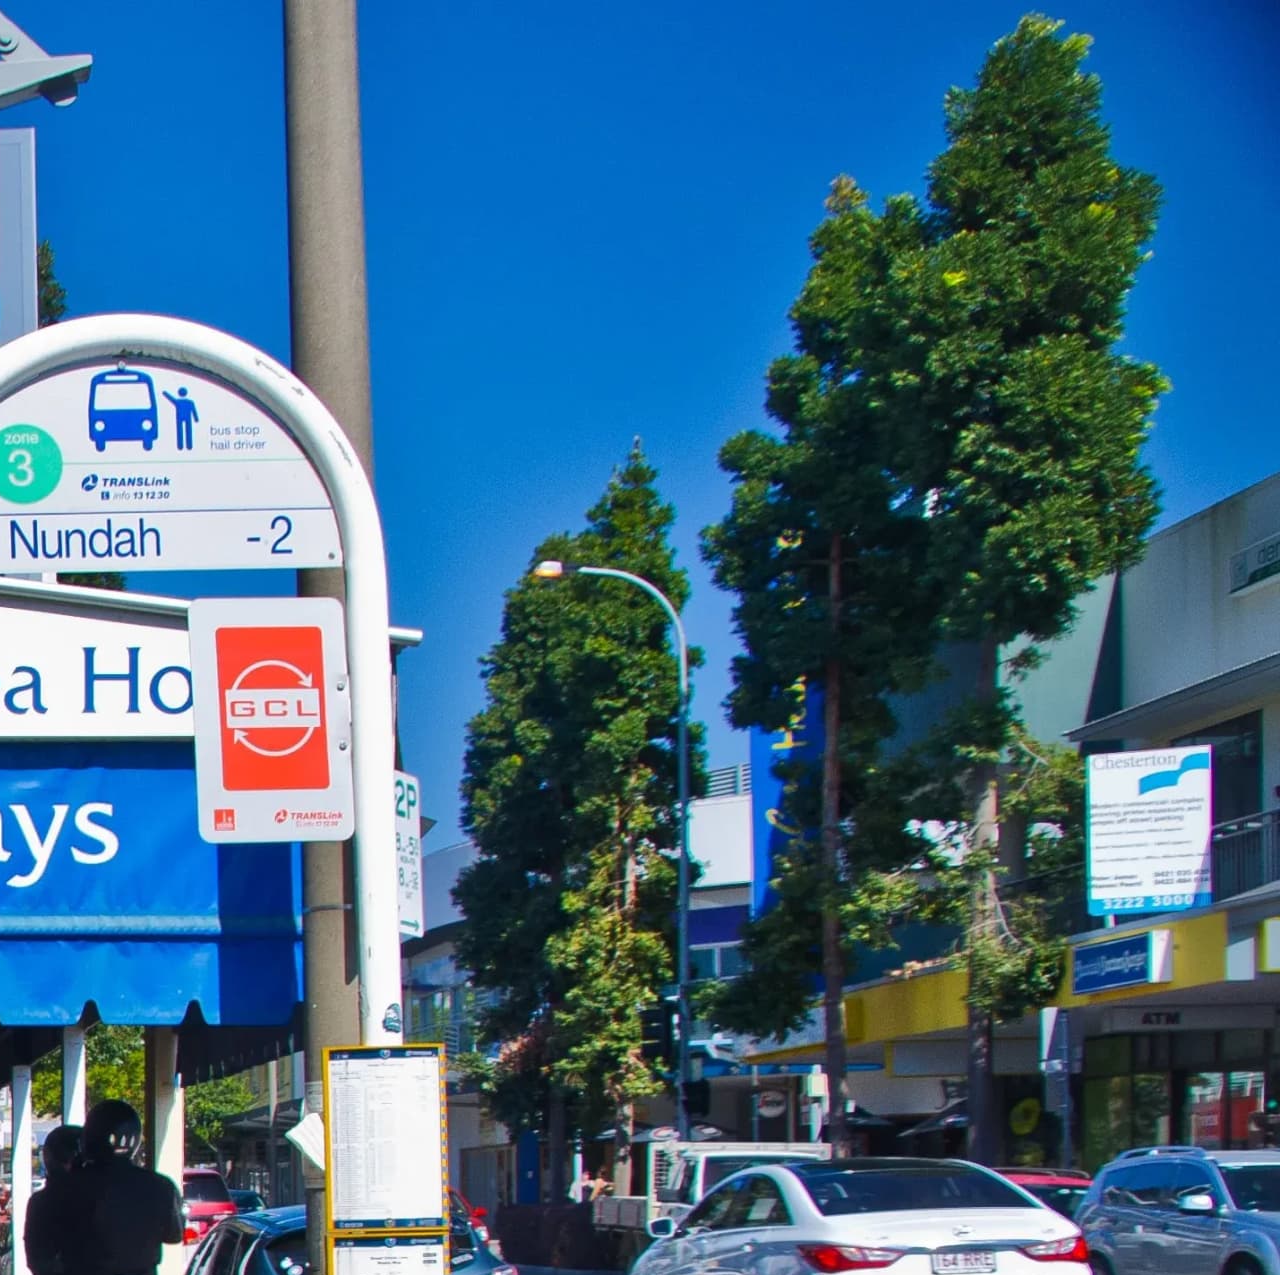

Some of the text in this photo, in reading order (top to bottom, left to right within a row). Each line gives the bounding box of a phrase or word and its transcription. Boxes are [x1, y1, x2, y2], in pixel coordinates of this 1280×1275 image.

[210, 424, 260, 438] bus stop
[4, 432, 39, 446] zone
[210, 438, 268, 451] hail driver
[8, 449, 35, 488] 3
[101, 476, 170, 488] TRANSLink
[112, 491, 131, 501] info
[9, 518, 162, 560] Nundah
[230, 699, 318, 717] GCL
[1092, 753, 1177, 771] Chesterton
[1103, 896, 1145, 910] 3222
[1142, 1012, 1181, 1025] ATM
